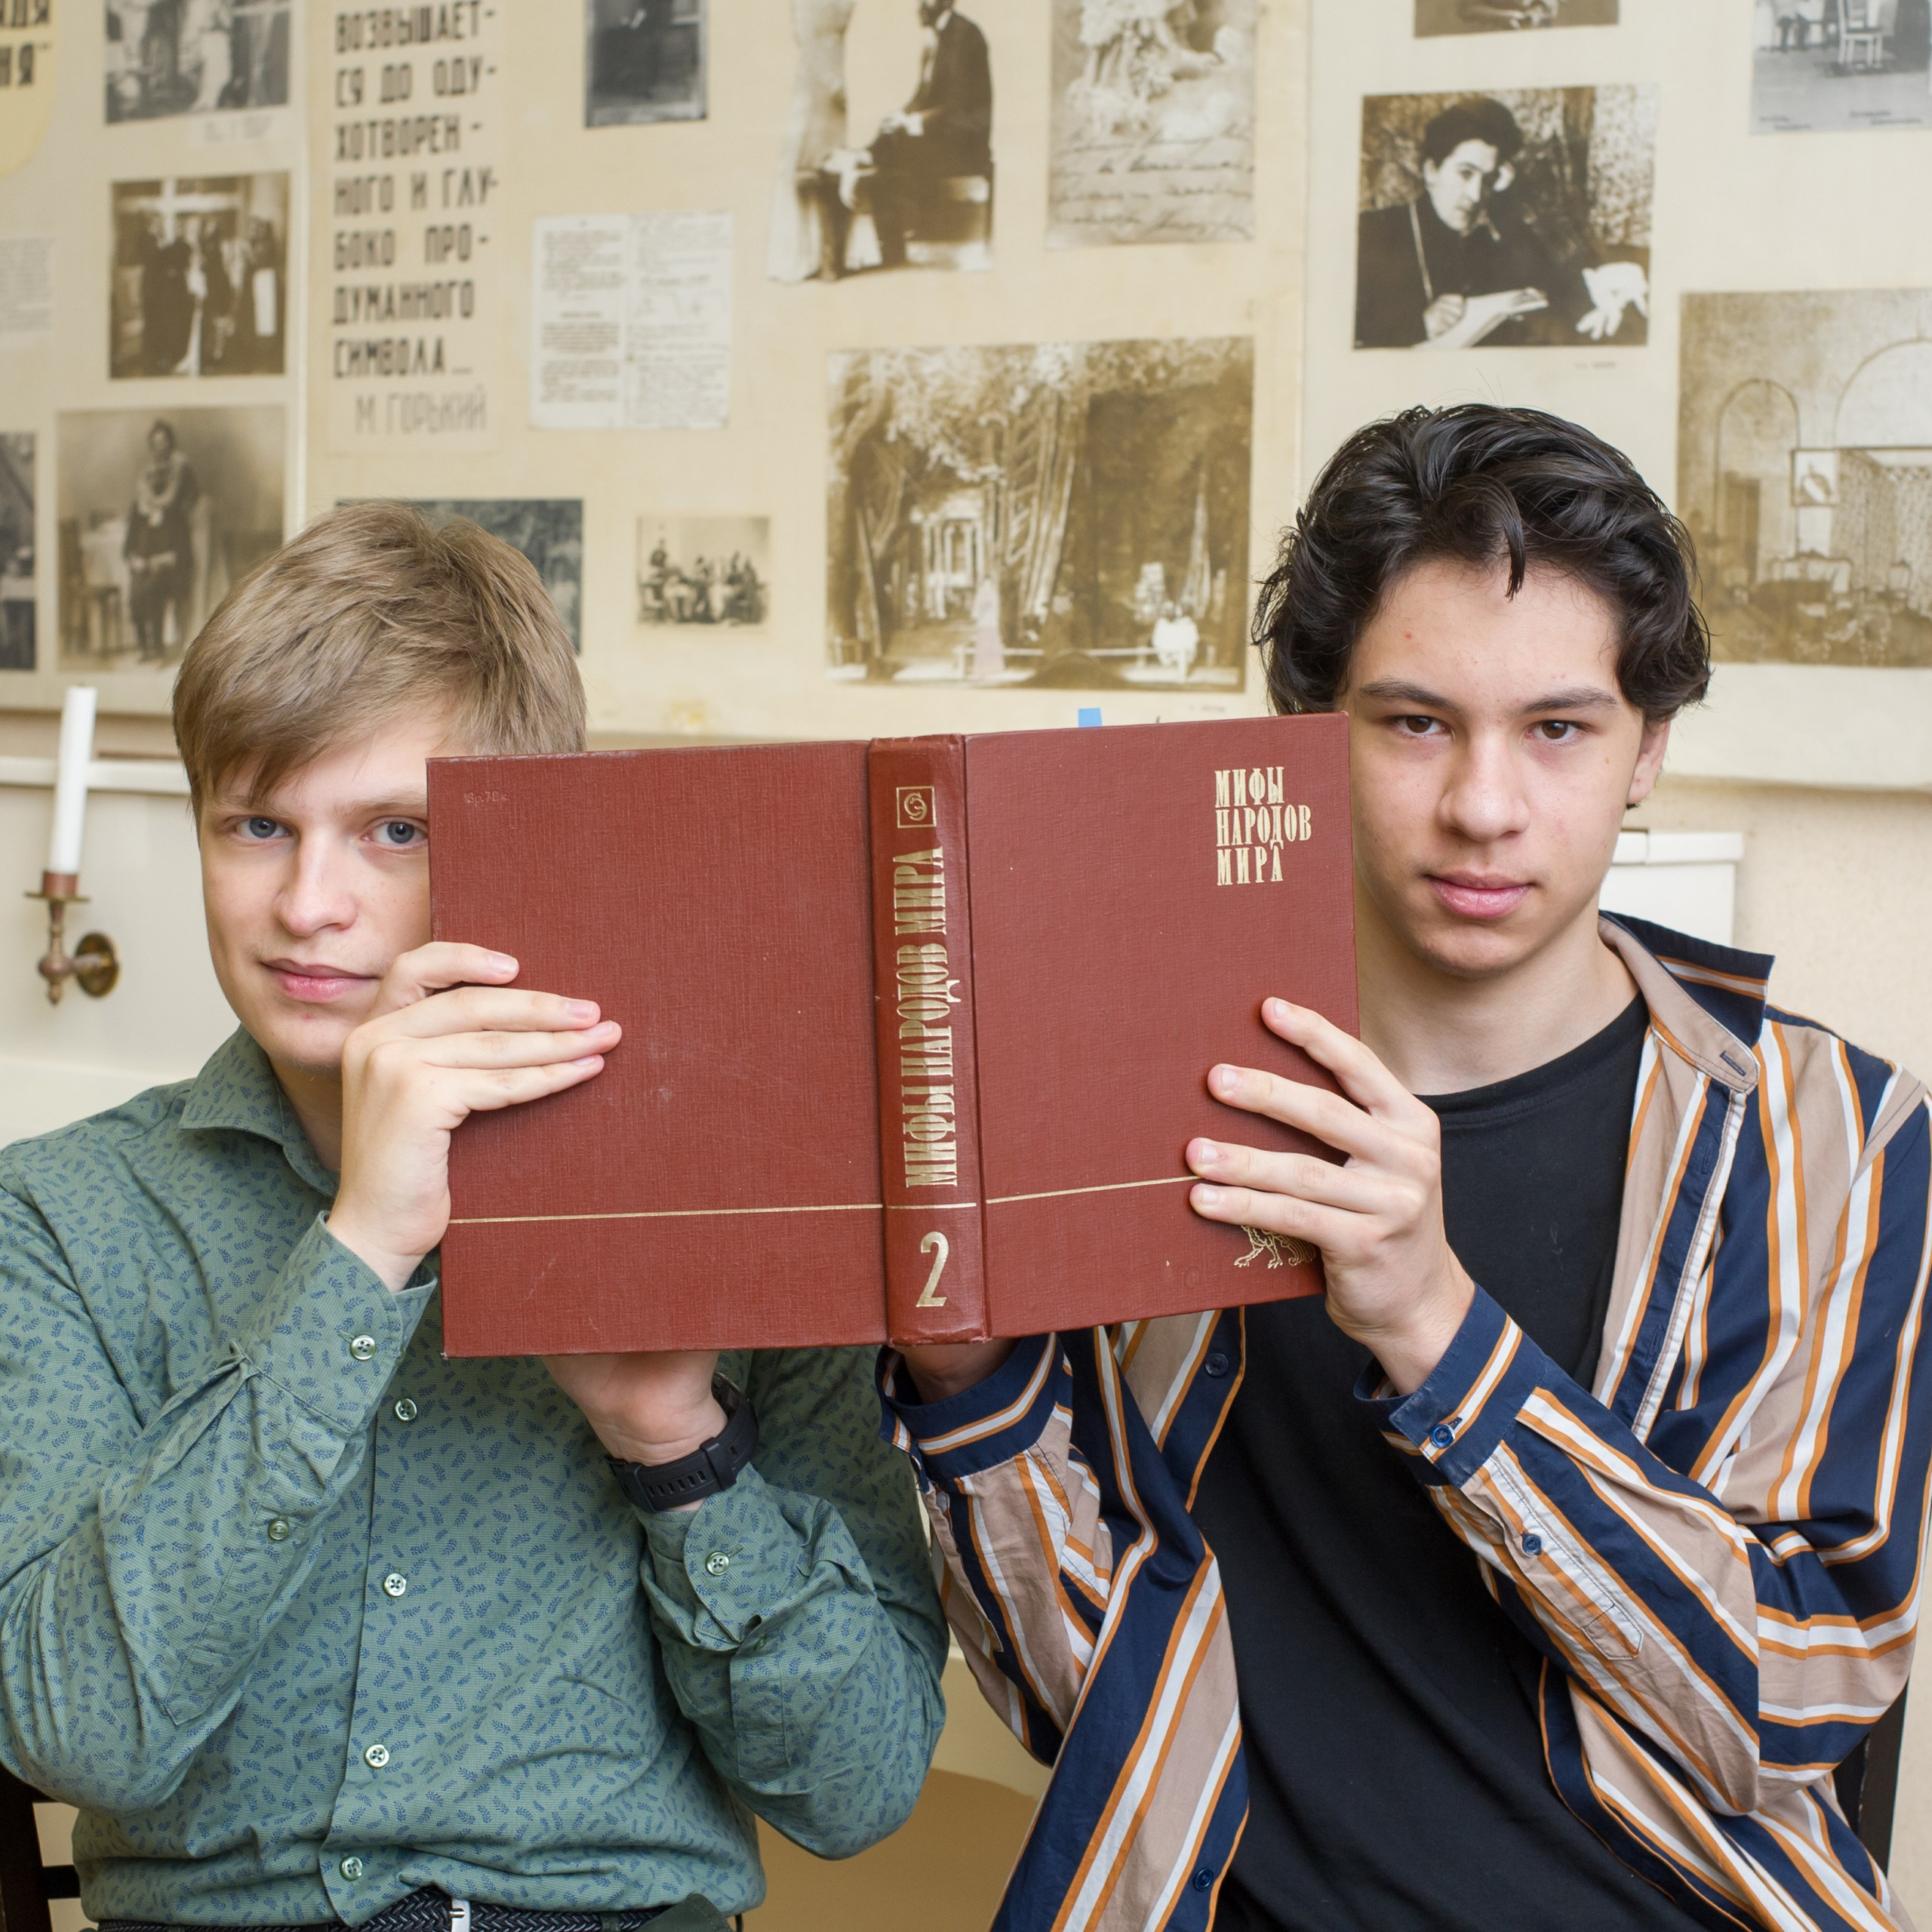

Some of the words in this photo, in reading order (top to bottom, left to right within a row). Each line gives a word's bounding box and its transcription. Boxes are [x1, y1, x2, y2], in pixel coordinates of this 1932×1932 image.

[336, 1, 494, 52] ВОЗВЫШАЕТ-
[336, 69, 364, 107] СЯ
[380, 63, 411, 103] ДО
[433, 56, 495, 96] ОДУ-
[335, 174, 394, 215] НОГО
[411, 172, 426, 209] И
[443, 168, 497, 208] ГЛУ-
[335, 229, 395, 270] БОКО
[425, 223, 488, 263] ПРО-
[333, 280, 473, 325] ДУМАННОГО
[1214, 766, 1285, 808] МИФЫ
[1215, 804, 1312, 850] НАРОДОВ
[1217, 844, 1284, 886] МИРА
[892, 845, 947, 936] МИРА
[896, 943, 961, 1078] НАРОДОВ
[902, 1084, 958, 1189] МИФЫ
[915, 1231, 949, 1307] 2
